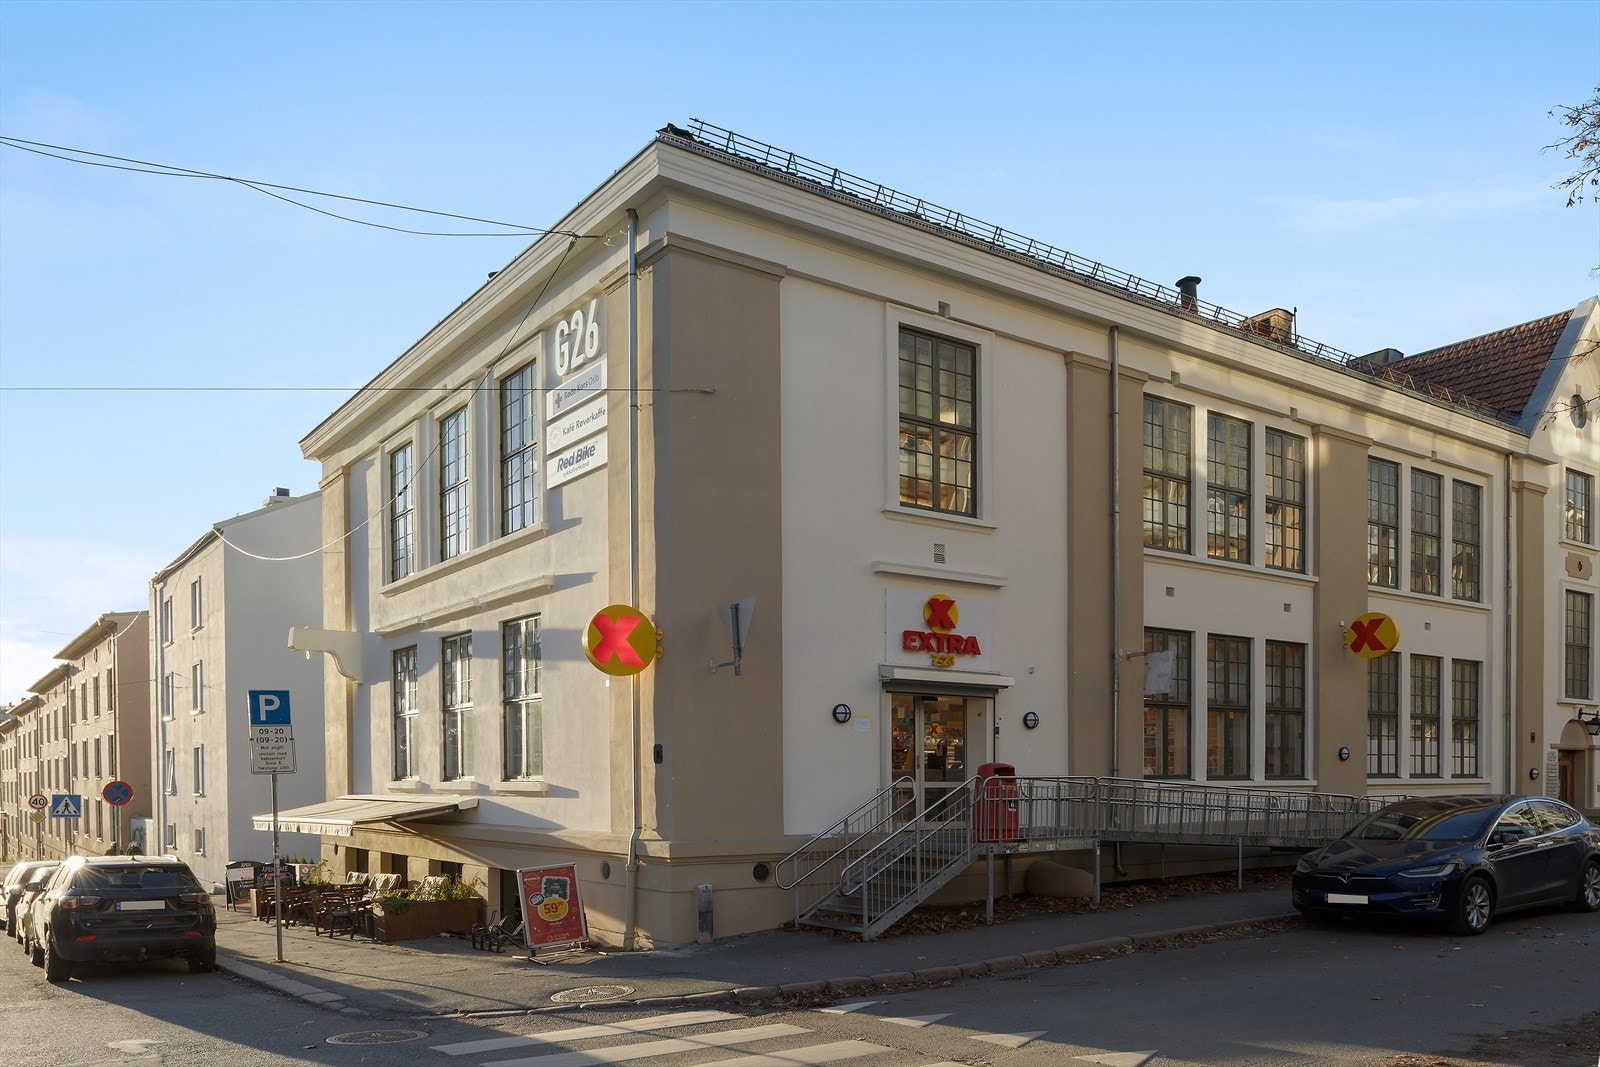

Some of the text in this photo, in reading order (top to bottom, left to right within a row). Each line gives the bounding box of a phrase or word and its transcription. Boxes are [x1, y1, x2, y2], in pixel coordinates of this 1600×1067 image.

[555, 298, 599, 376] G26
[557, 445, 596, 472] Red Bike
[902, 630, 982, 656] EXTRA
[259, 694, 281, 721] P
[32, 797, 45, 806] 40
